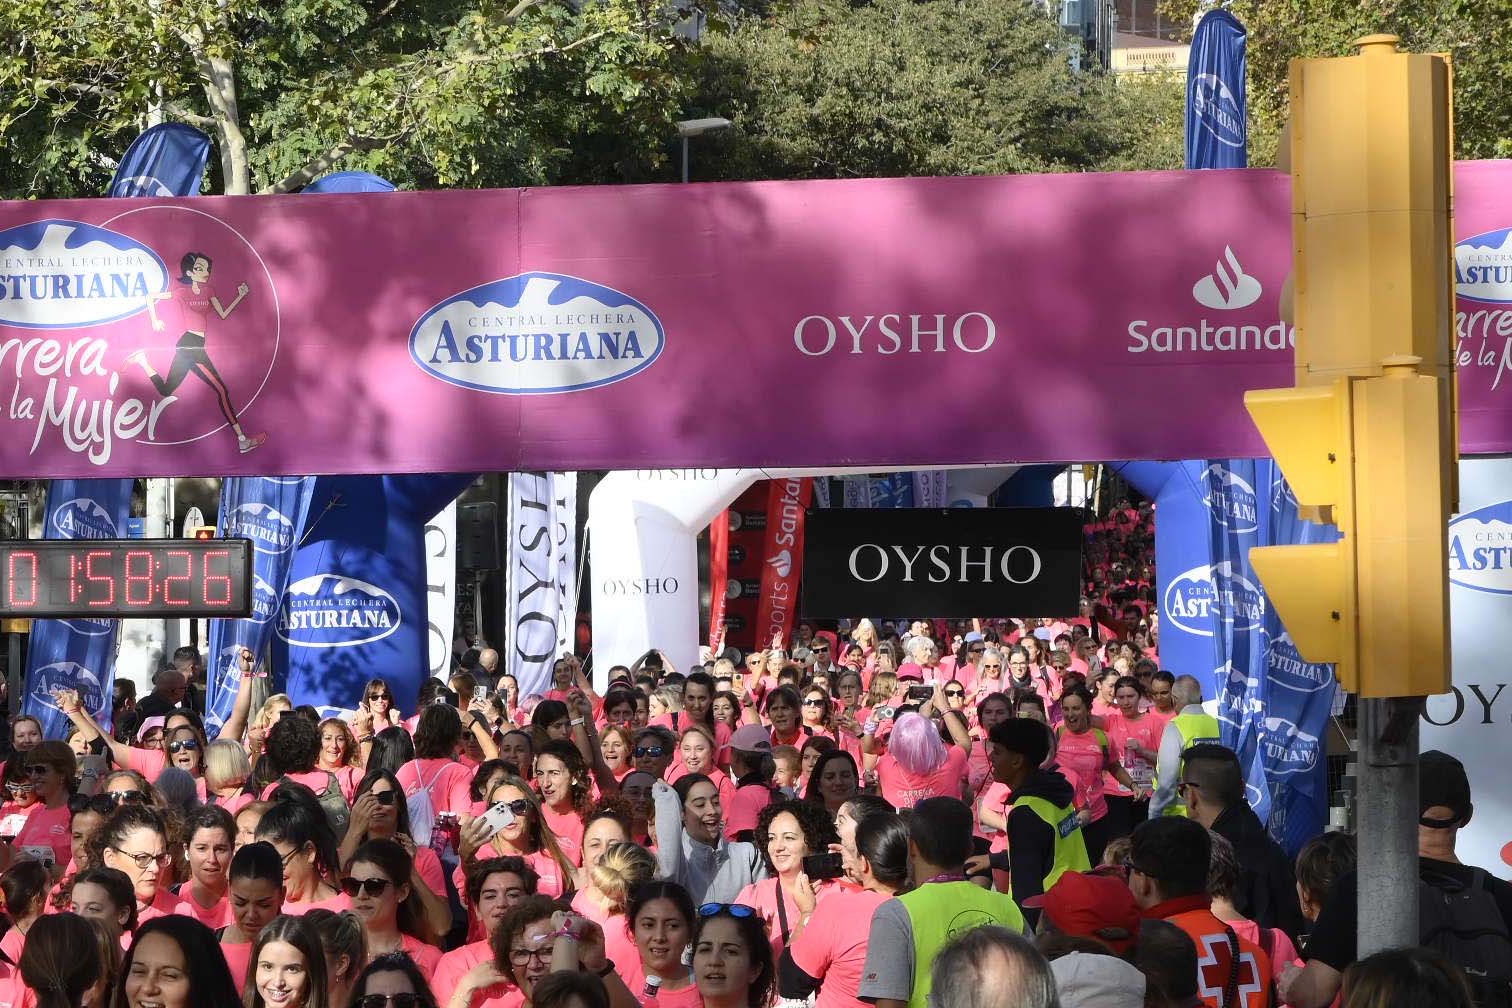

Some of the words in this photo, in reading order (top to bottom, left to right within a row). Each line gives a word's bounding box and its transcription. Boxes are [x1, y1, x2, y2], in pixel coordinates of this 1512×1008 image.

[72, 255, 144, 269] LECHERA
[468, 314, 547, 328] CENTRAL
[555, 312, 636, 325] LECHERA
[794, 312, 996, 356] OYSHO
[1127, 319, 1295, 354] Santand
[429, 319, 645, 364] ASTURIANA
[10, 380, 34, 420] la
[29, 371, 179, 466] Mujer
[9, 551, 231, 606] 01:58:26
[848, 543, 1042, 584] OYSHO
[291, 599, 334, 608] CENTRAL
[338, 598, 388, 607] LECHERA
[604, 577, 679, 597] OYSHO
[279, 604, 392, 631] ASTURIANA
